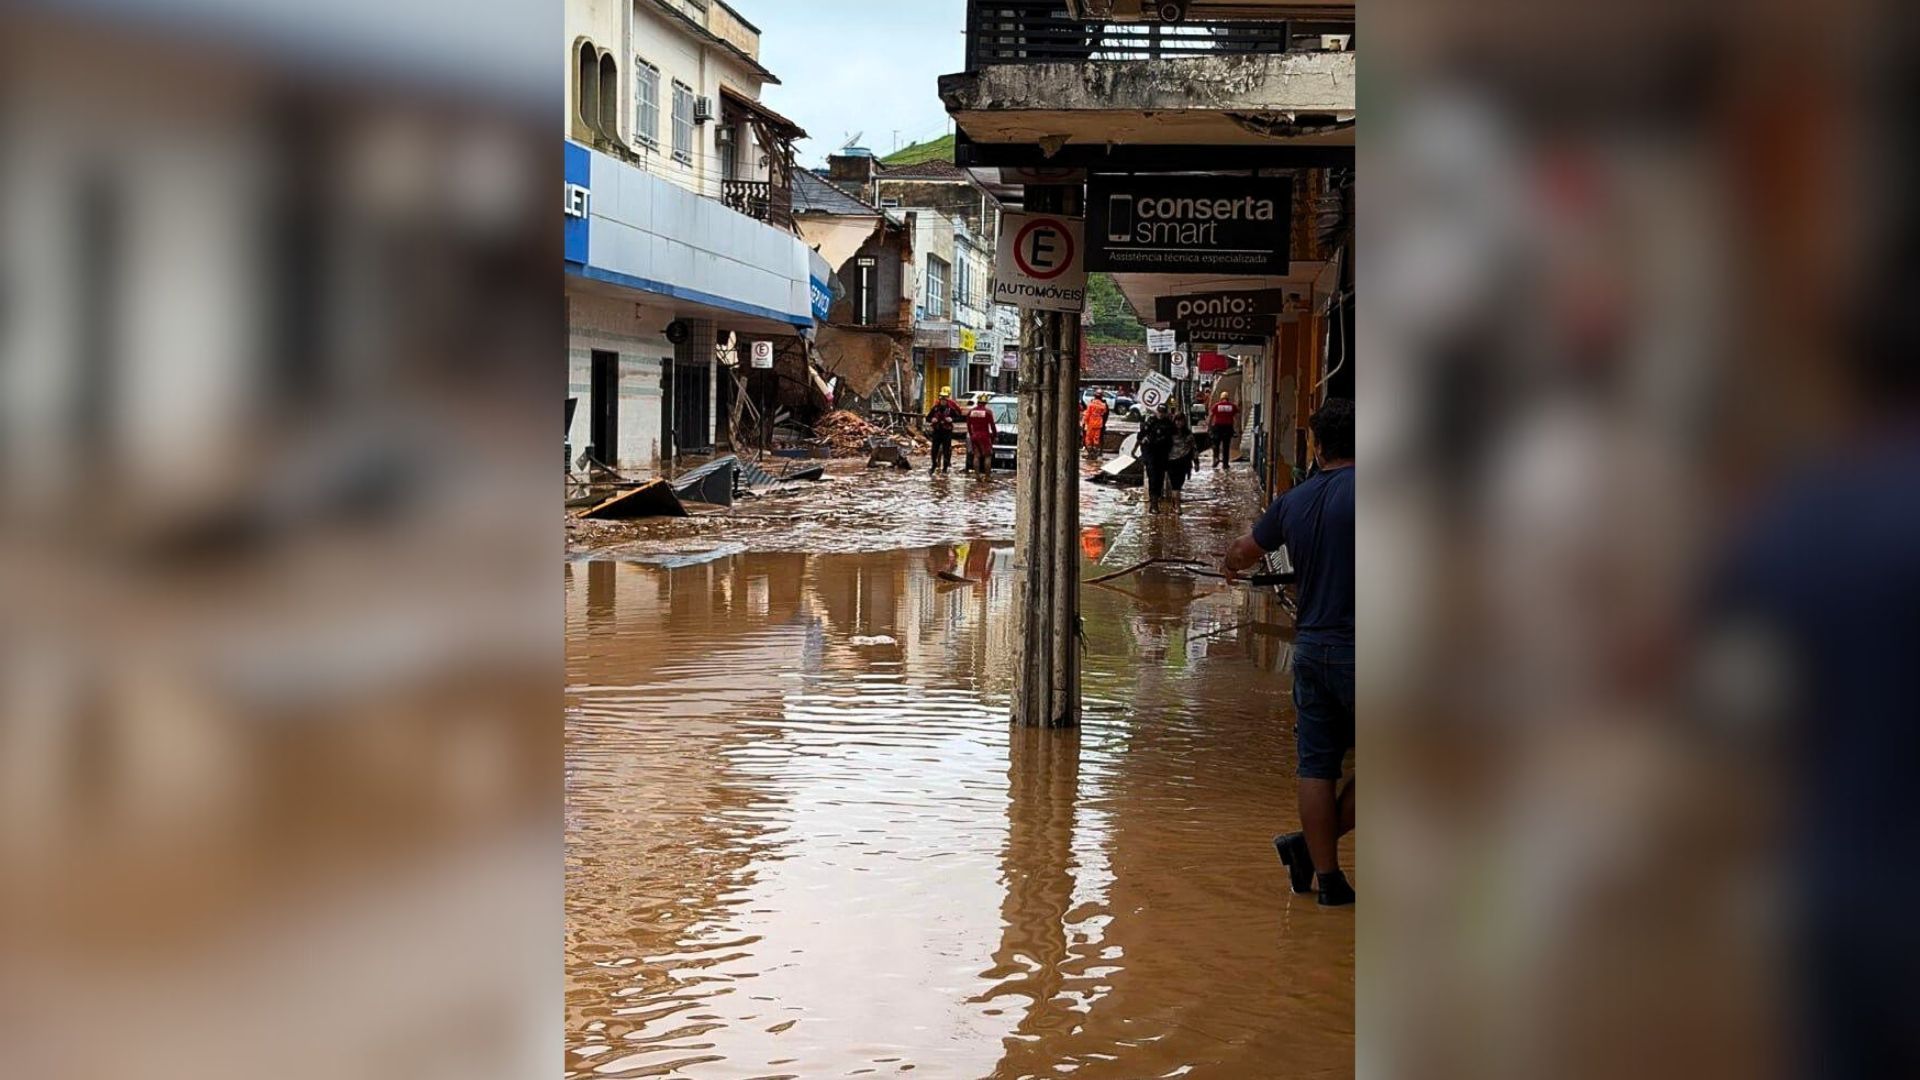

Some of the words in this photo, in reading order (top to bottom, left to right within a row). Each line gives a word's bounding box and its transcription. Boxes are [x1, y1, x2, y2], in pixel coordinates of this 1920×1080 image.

[1136, 196, 1273, 220] conserta
[1136, 222, 1217, 244] smart
[1032, 230, 1054, 266] E
[1109, 251, 1162, 262] Assistência
[1164, 252, 1199, 263] técnica
[1202, 254, 1267, 265] especializada
[998, 282, 1082, 301] AUTOMÓVEIS
[1177, 296, 1253, 319] ponto:
